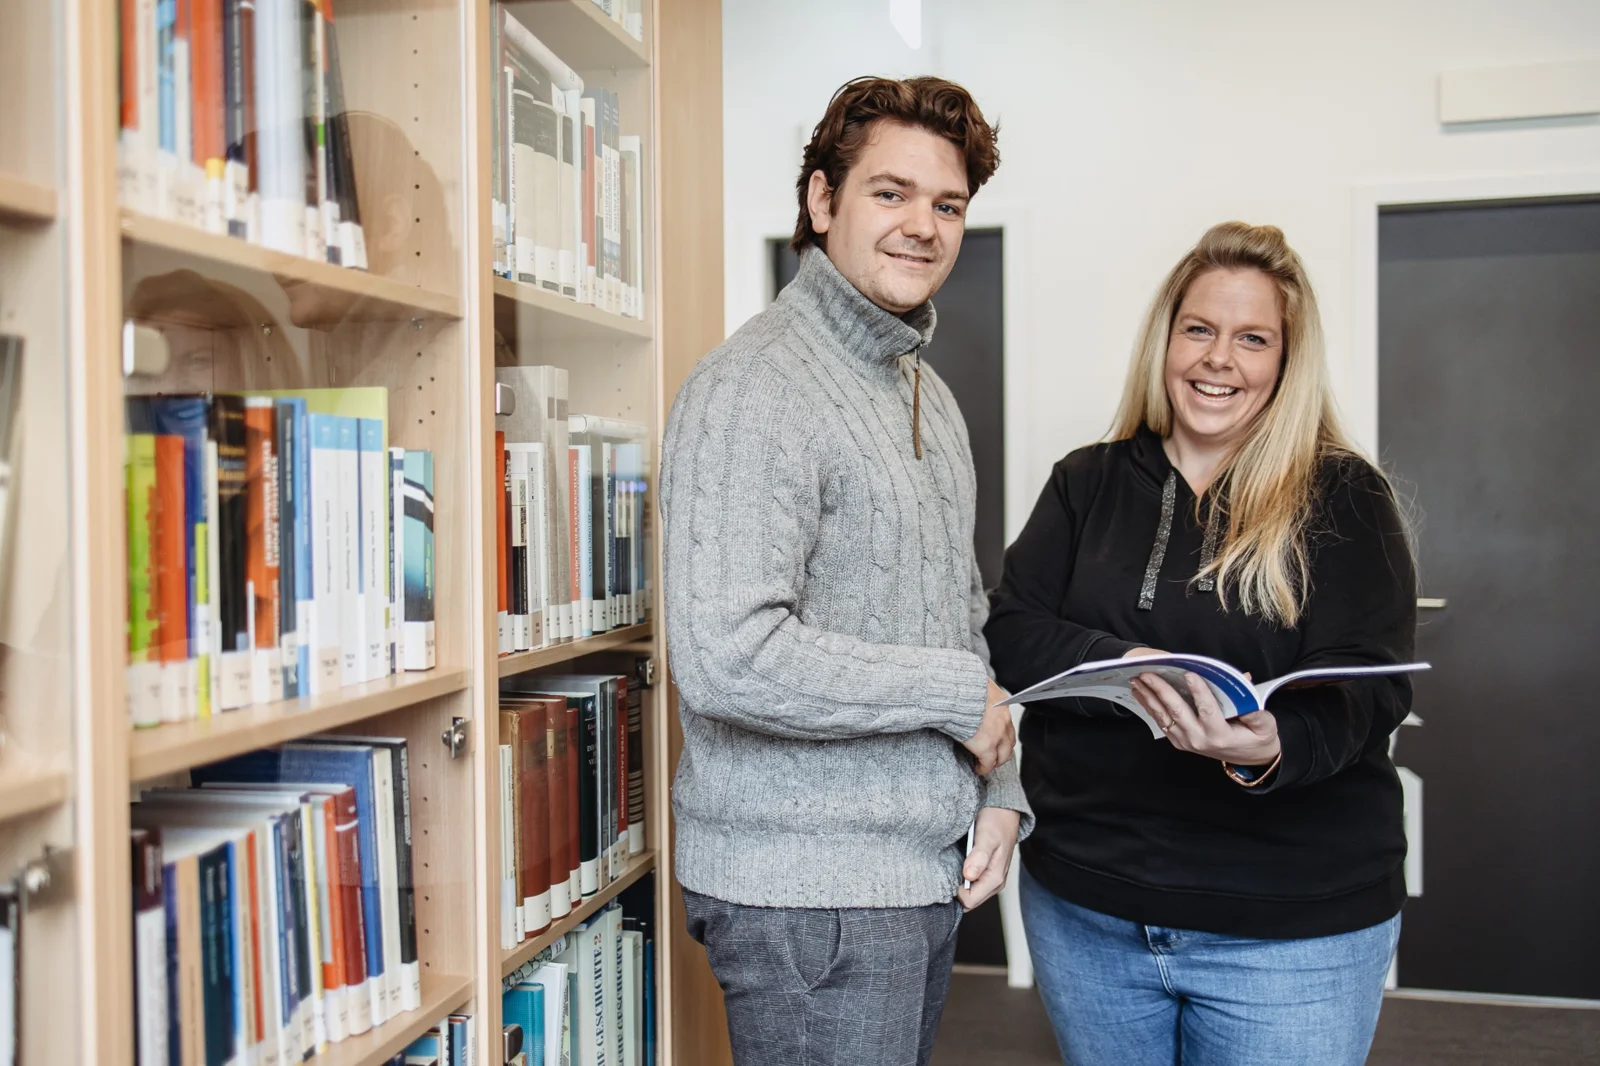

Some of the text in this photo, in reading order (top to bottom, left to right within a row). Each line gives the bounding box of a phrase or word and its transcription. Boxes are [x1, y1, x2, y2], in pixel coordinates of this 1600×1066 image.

[594, 933, 602, 945] 2
[616, 934, 624, 1031] GESCHICHTE
[593, 946, 605, 1047] GESCHICHTE
